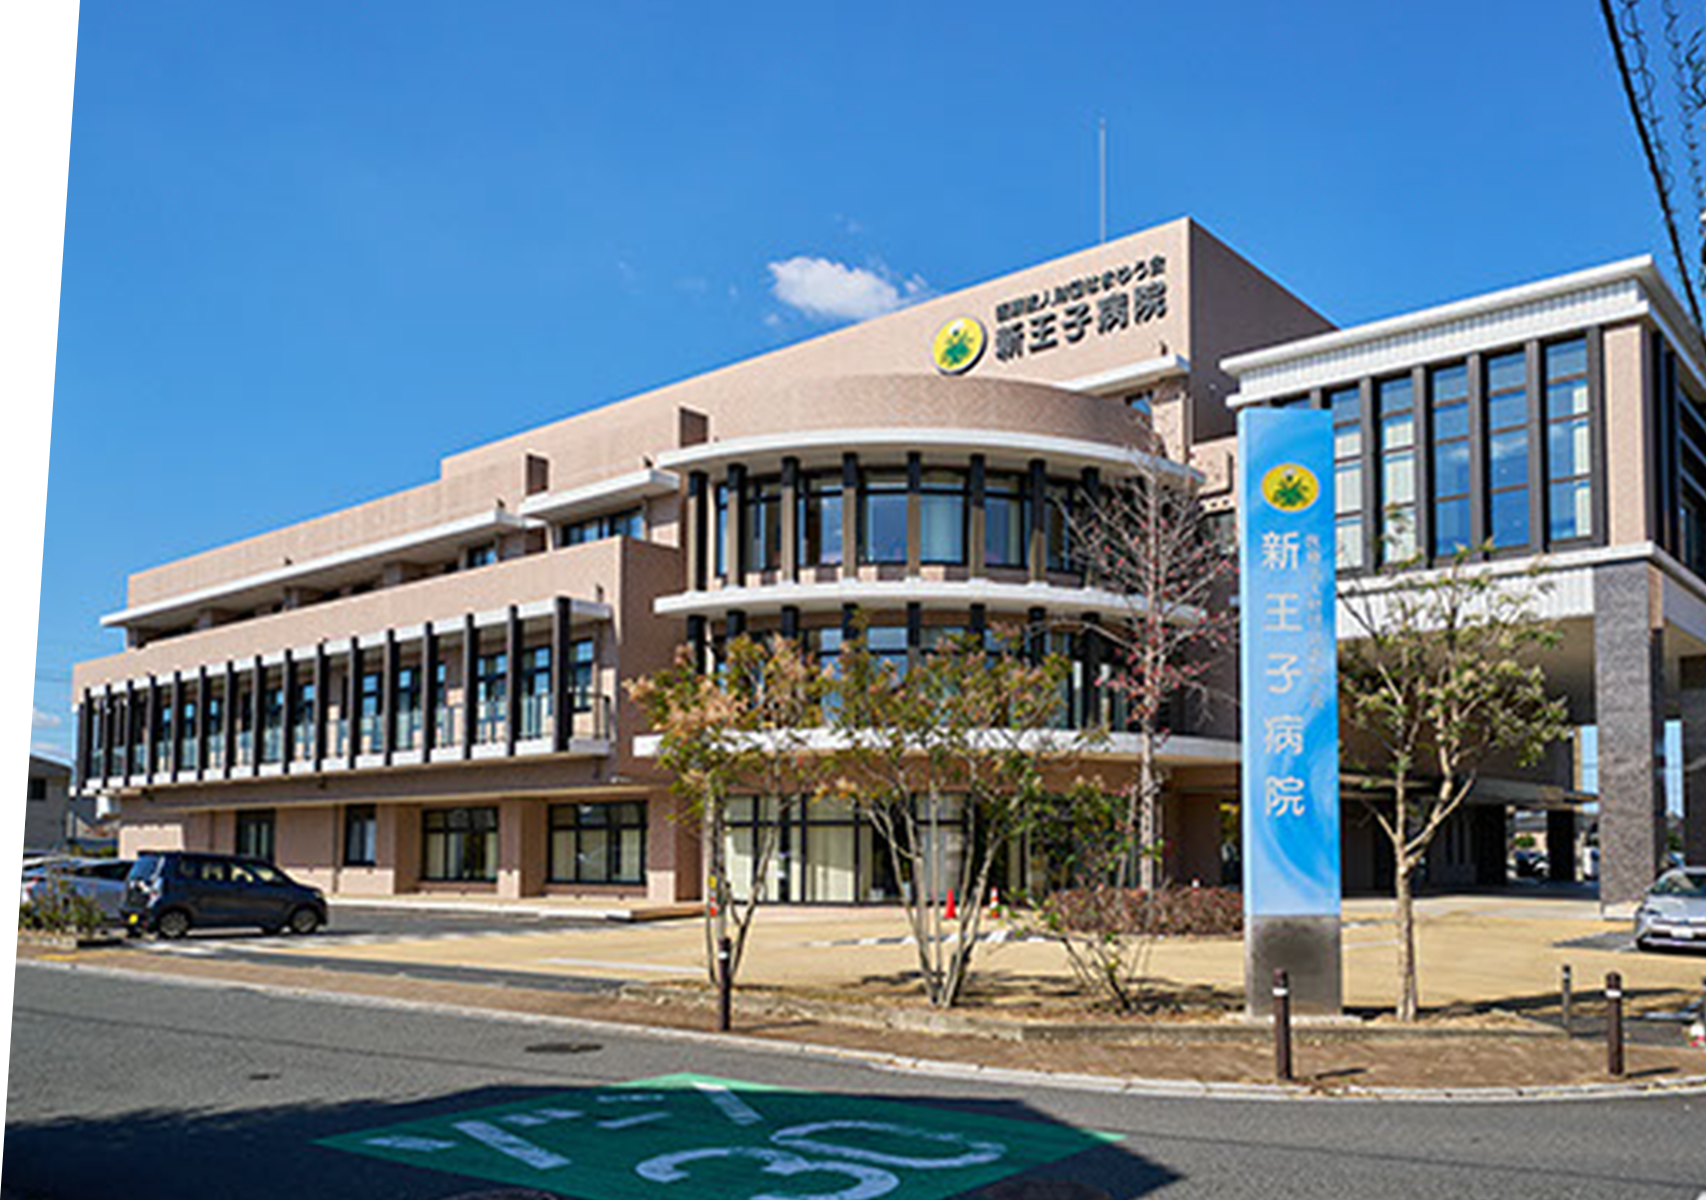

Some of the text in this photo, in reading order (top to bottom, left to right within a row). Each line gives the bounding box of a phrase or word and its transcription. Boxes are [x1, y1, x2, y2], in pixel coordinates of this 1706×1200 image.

[996, 280, 1168, 362] 新王子病院
[1261, 531, 1305, 816] 新王子病院
[362, 1081, 763, 1170] ゾーン
[635, 1119, 1007, 1200] 30
